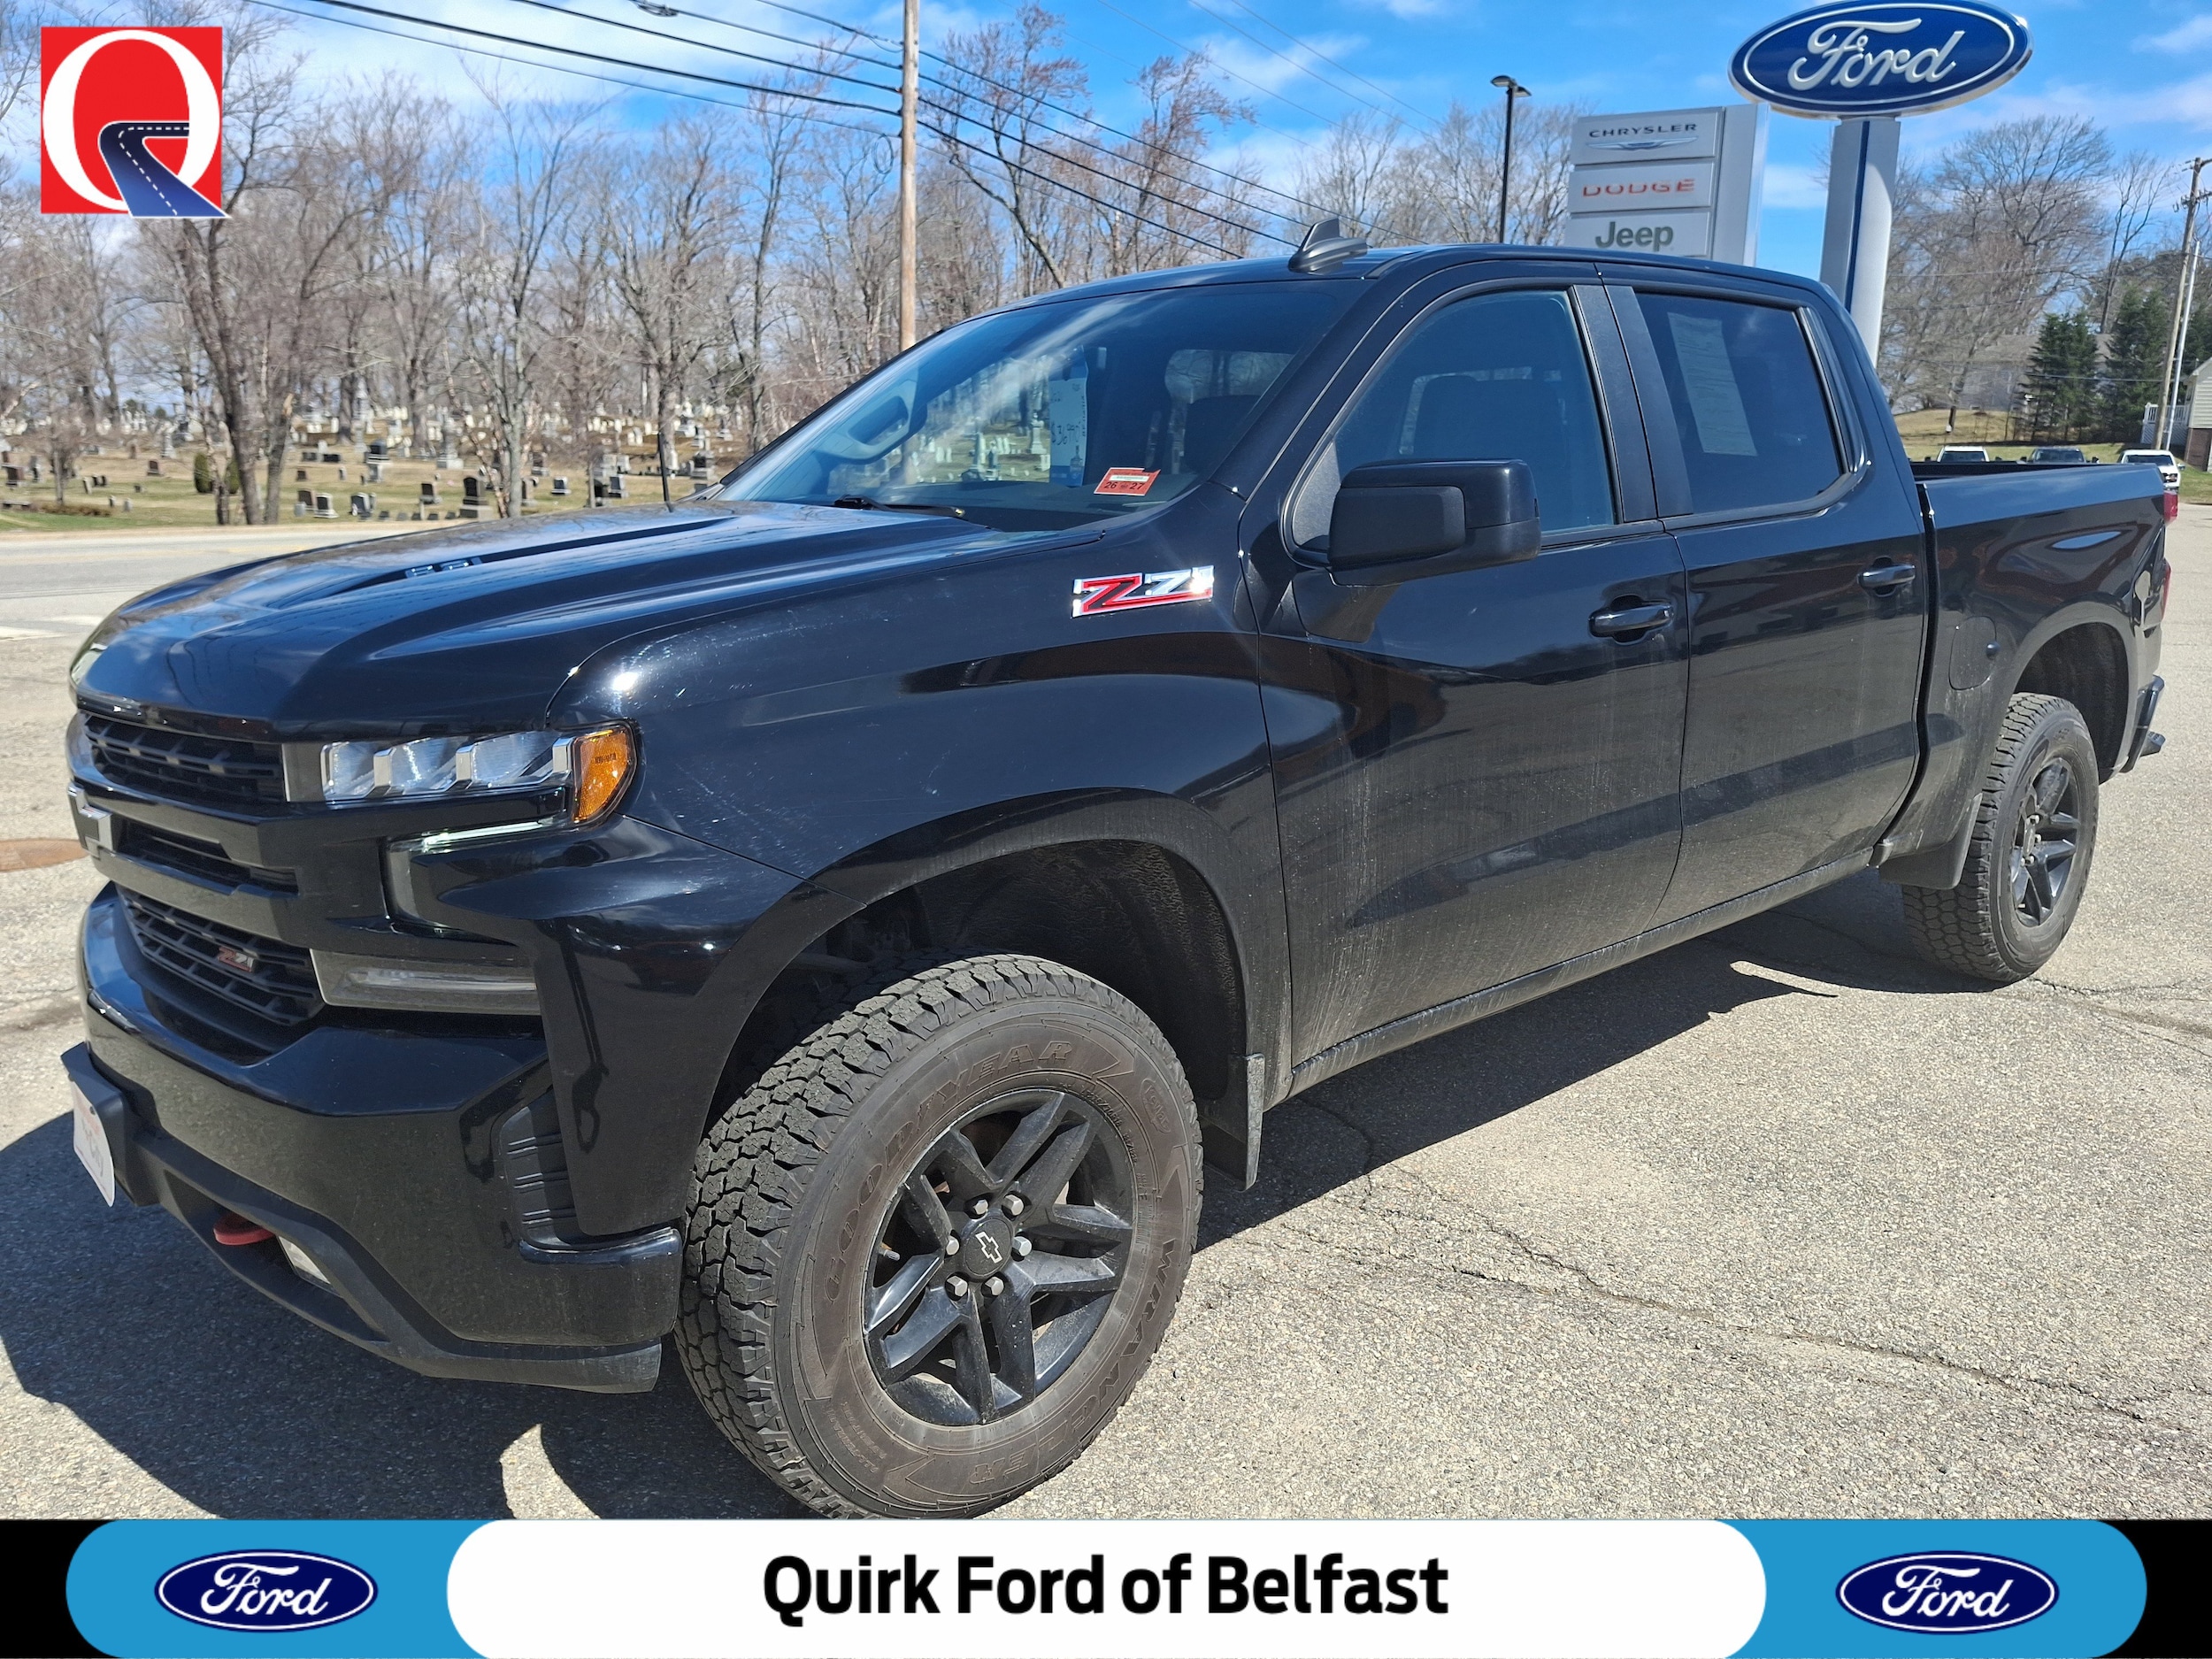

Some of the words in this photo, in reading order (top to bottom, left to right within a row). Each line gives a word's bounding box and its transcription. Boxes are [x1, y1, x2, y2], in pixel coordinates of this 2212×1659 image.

[1787, 18, 1965, 90] Ford
[1589, 123, 1698, 138] CHRYSLER
[1583, 179, 1695, 197] DODGE
[1594, 221, 1674, 252] Jeep
[218, 946, 255, 972] Z71
[970, 1238, 1176, 1484] WRANGLER
